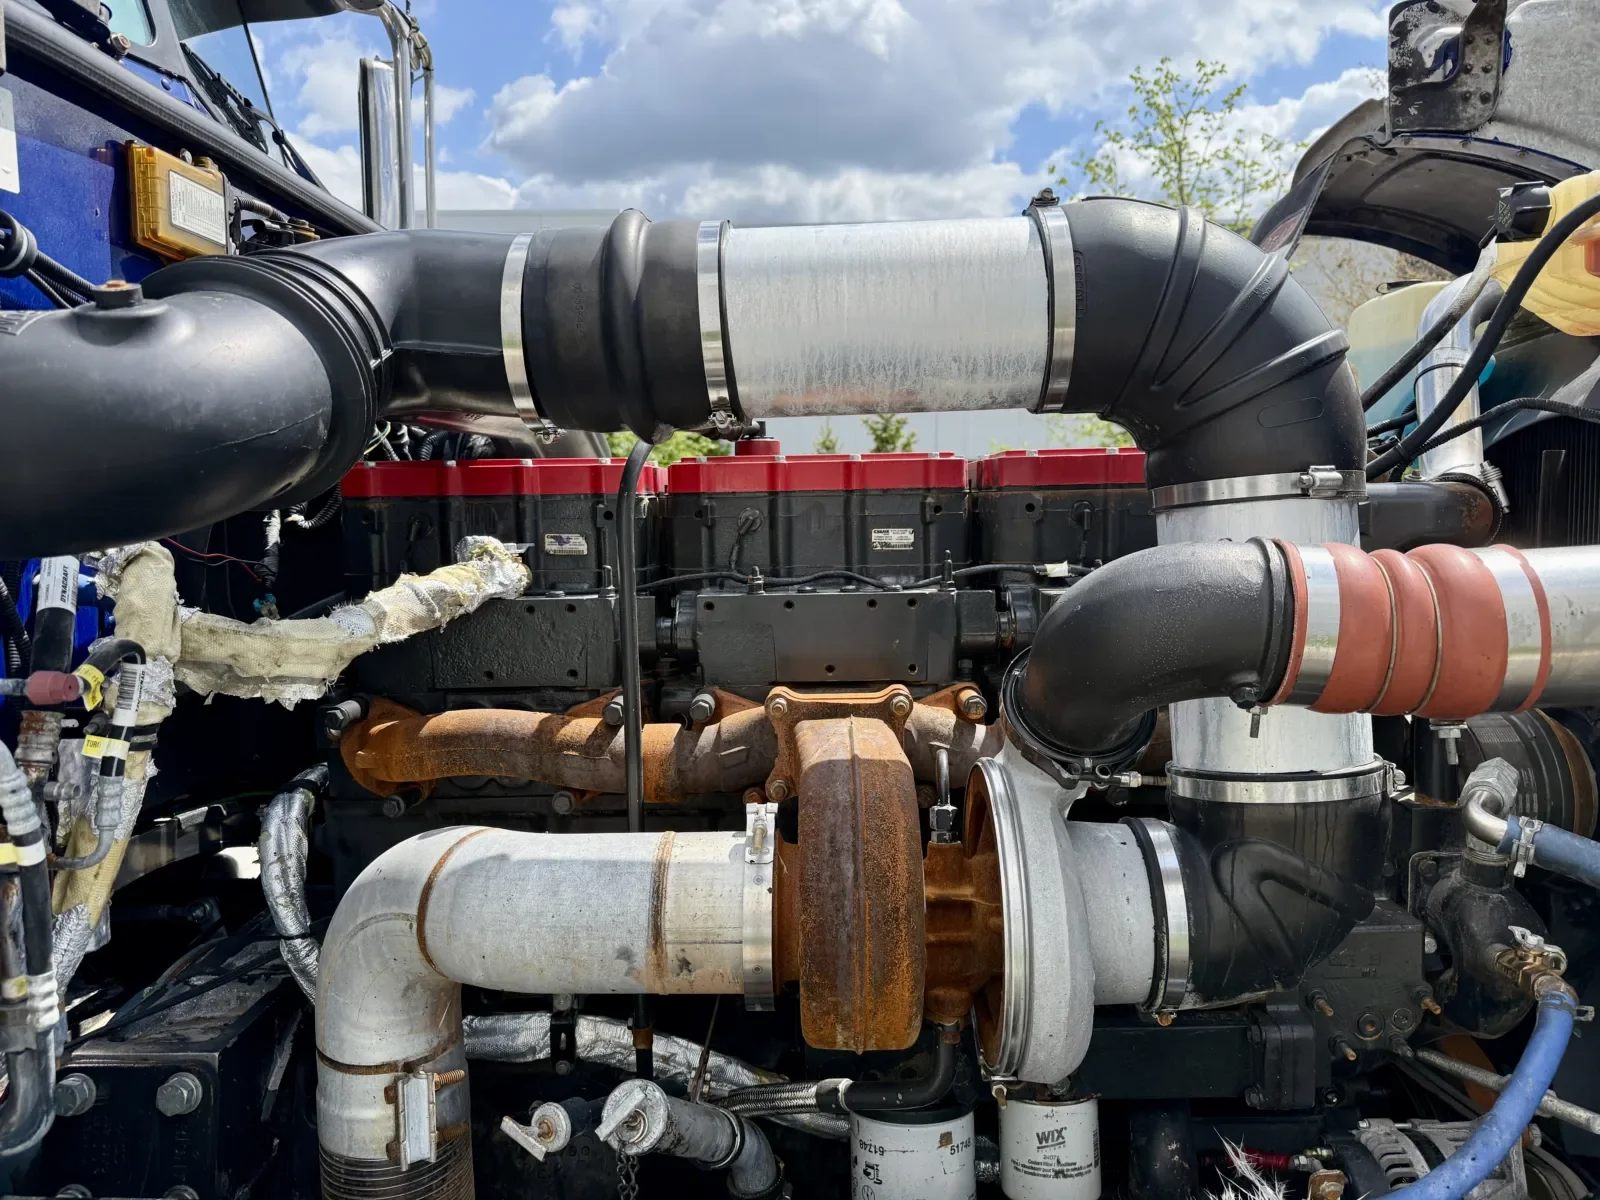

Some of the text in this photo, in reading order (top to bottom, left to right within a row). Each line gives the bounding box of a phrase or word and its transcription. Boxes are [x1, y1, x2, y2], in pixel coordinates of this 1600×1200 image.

[60, 564, 69, 604] DYNACRAFT
[1036, 1127, 1066, 1145] WIX
[859, 1139, 885, 1156] 51748
